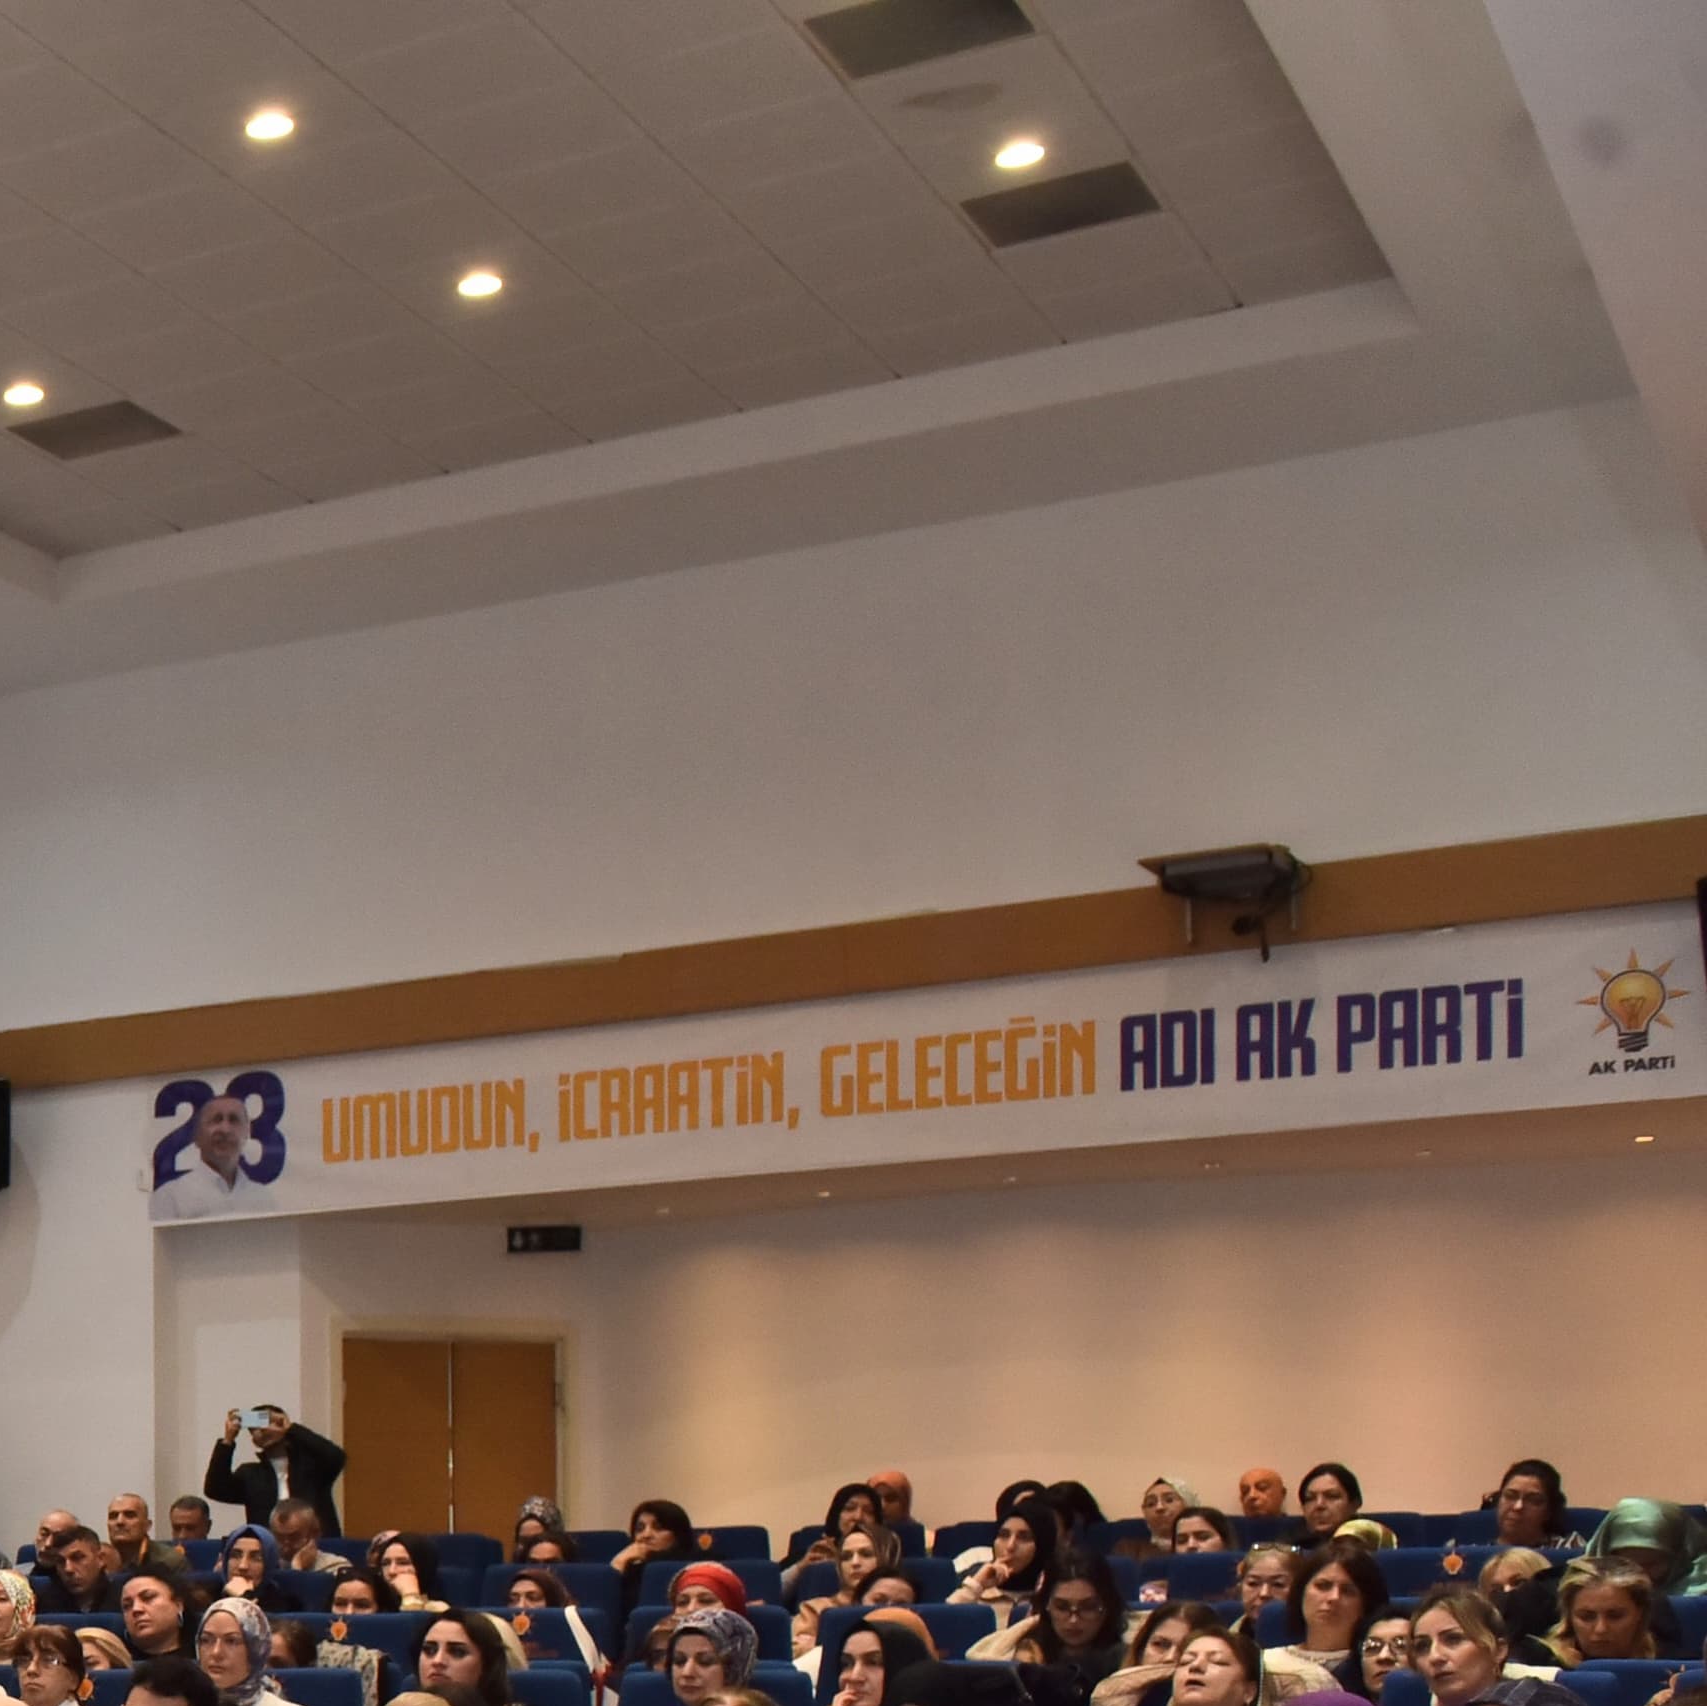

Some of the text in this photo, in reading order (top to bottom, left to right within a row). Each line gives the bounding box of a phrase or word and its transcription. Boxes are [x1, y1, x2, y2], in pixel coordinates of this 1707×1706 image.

[322, 977, 1524, 1163] UMUDUN, İCRAATİN, GELECEĞİN ADI AK PARTİ
[1588, 1055, 1676, 1076] AK PARTİ
